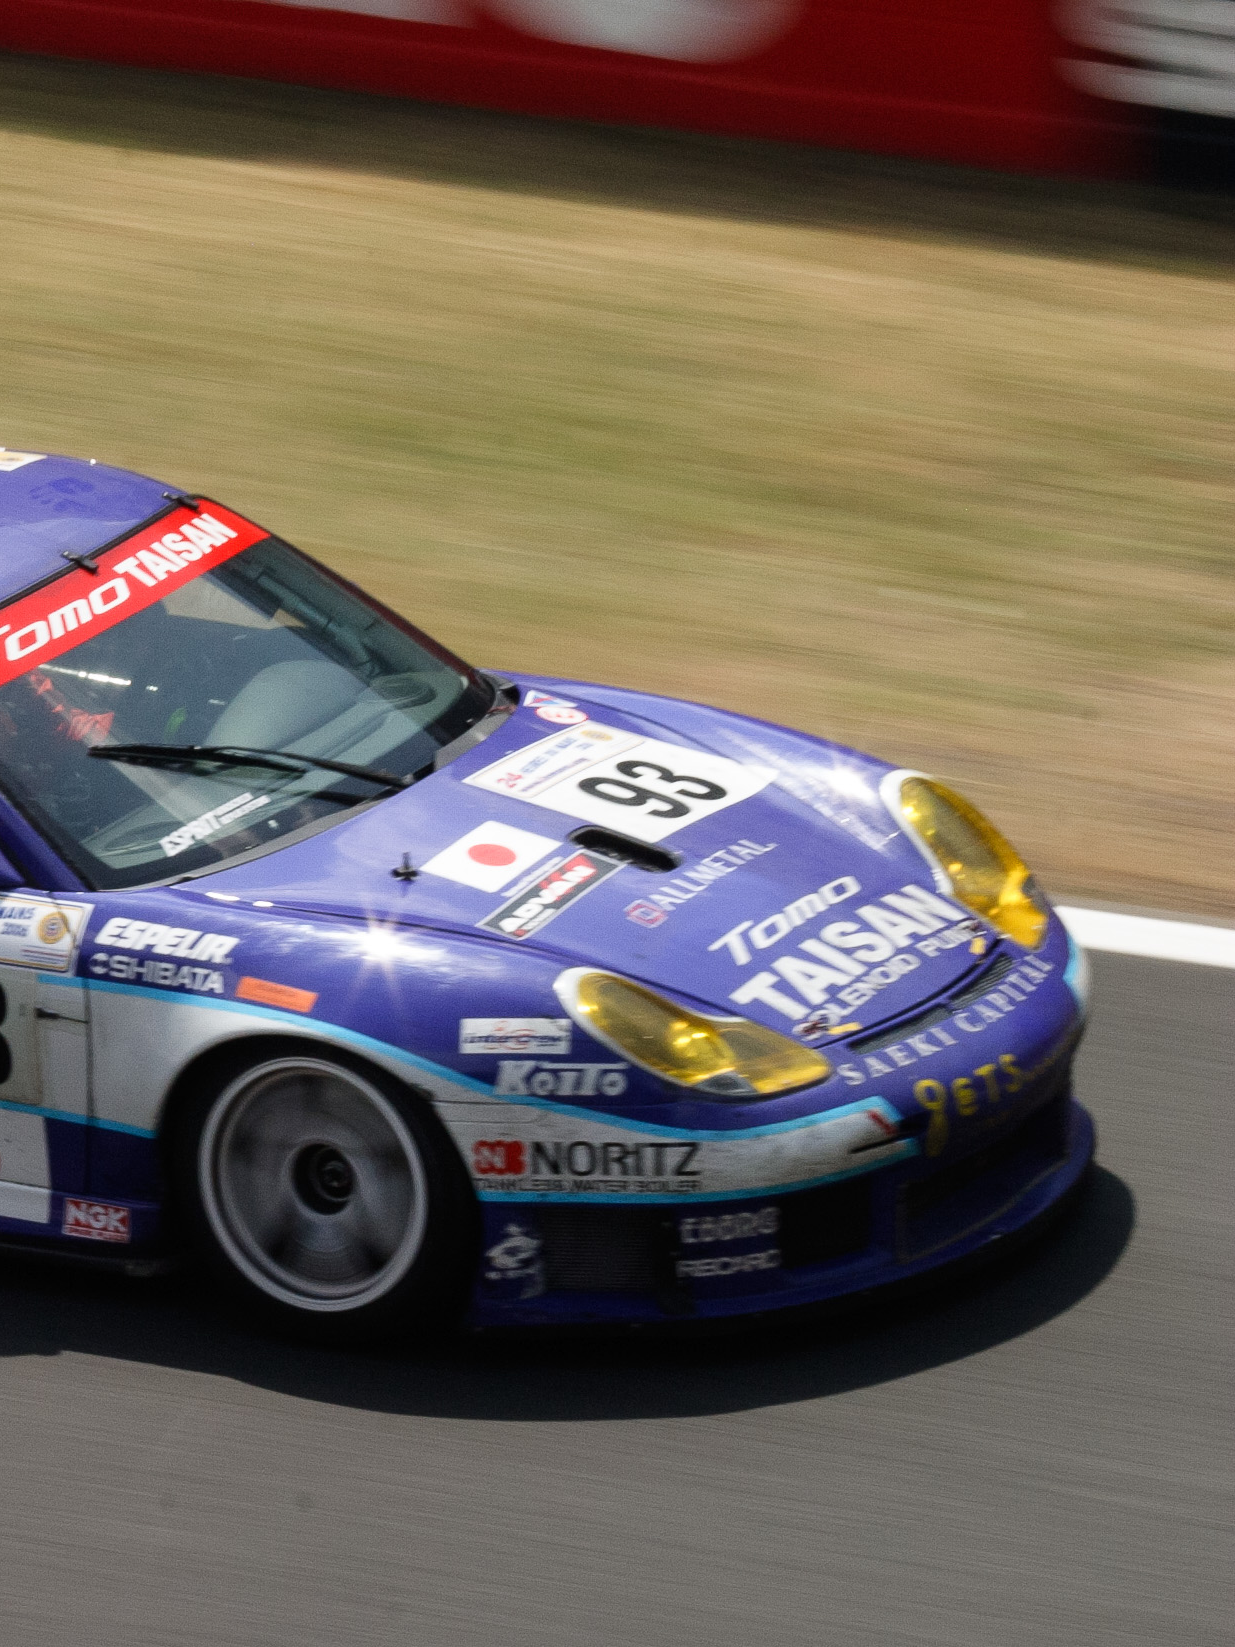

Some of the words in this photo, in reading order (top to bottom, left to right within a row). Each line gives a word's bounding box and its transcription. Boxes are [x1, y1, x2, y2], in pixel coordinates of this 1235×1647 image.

[112, 513, 238, 588] TAISAN
[577, 760, 728, 819] 93
[649, 838, 781, 911] ALLMETAL
[108, 954, 226, 994] SHIBATA
[729, 883, 970, 1021] TAISAN
[836, 1029, 959, 1086] SAEKI
[956, 954, 1054, 1033] CAPITAL
[531, 1140, 702, 1177] NORITZ
[66, 1201, 129, 1232] NGK
